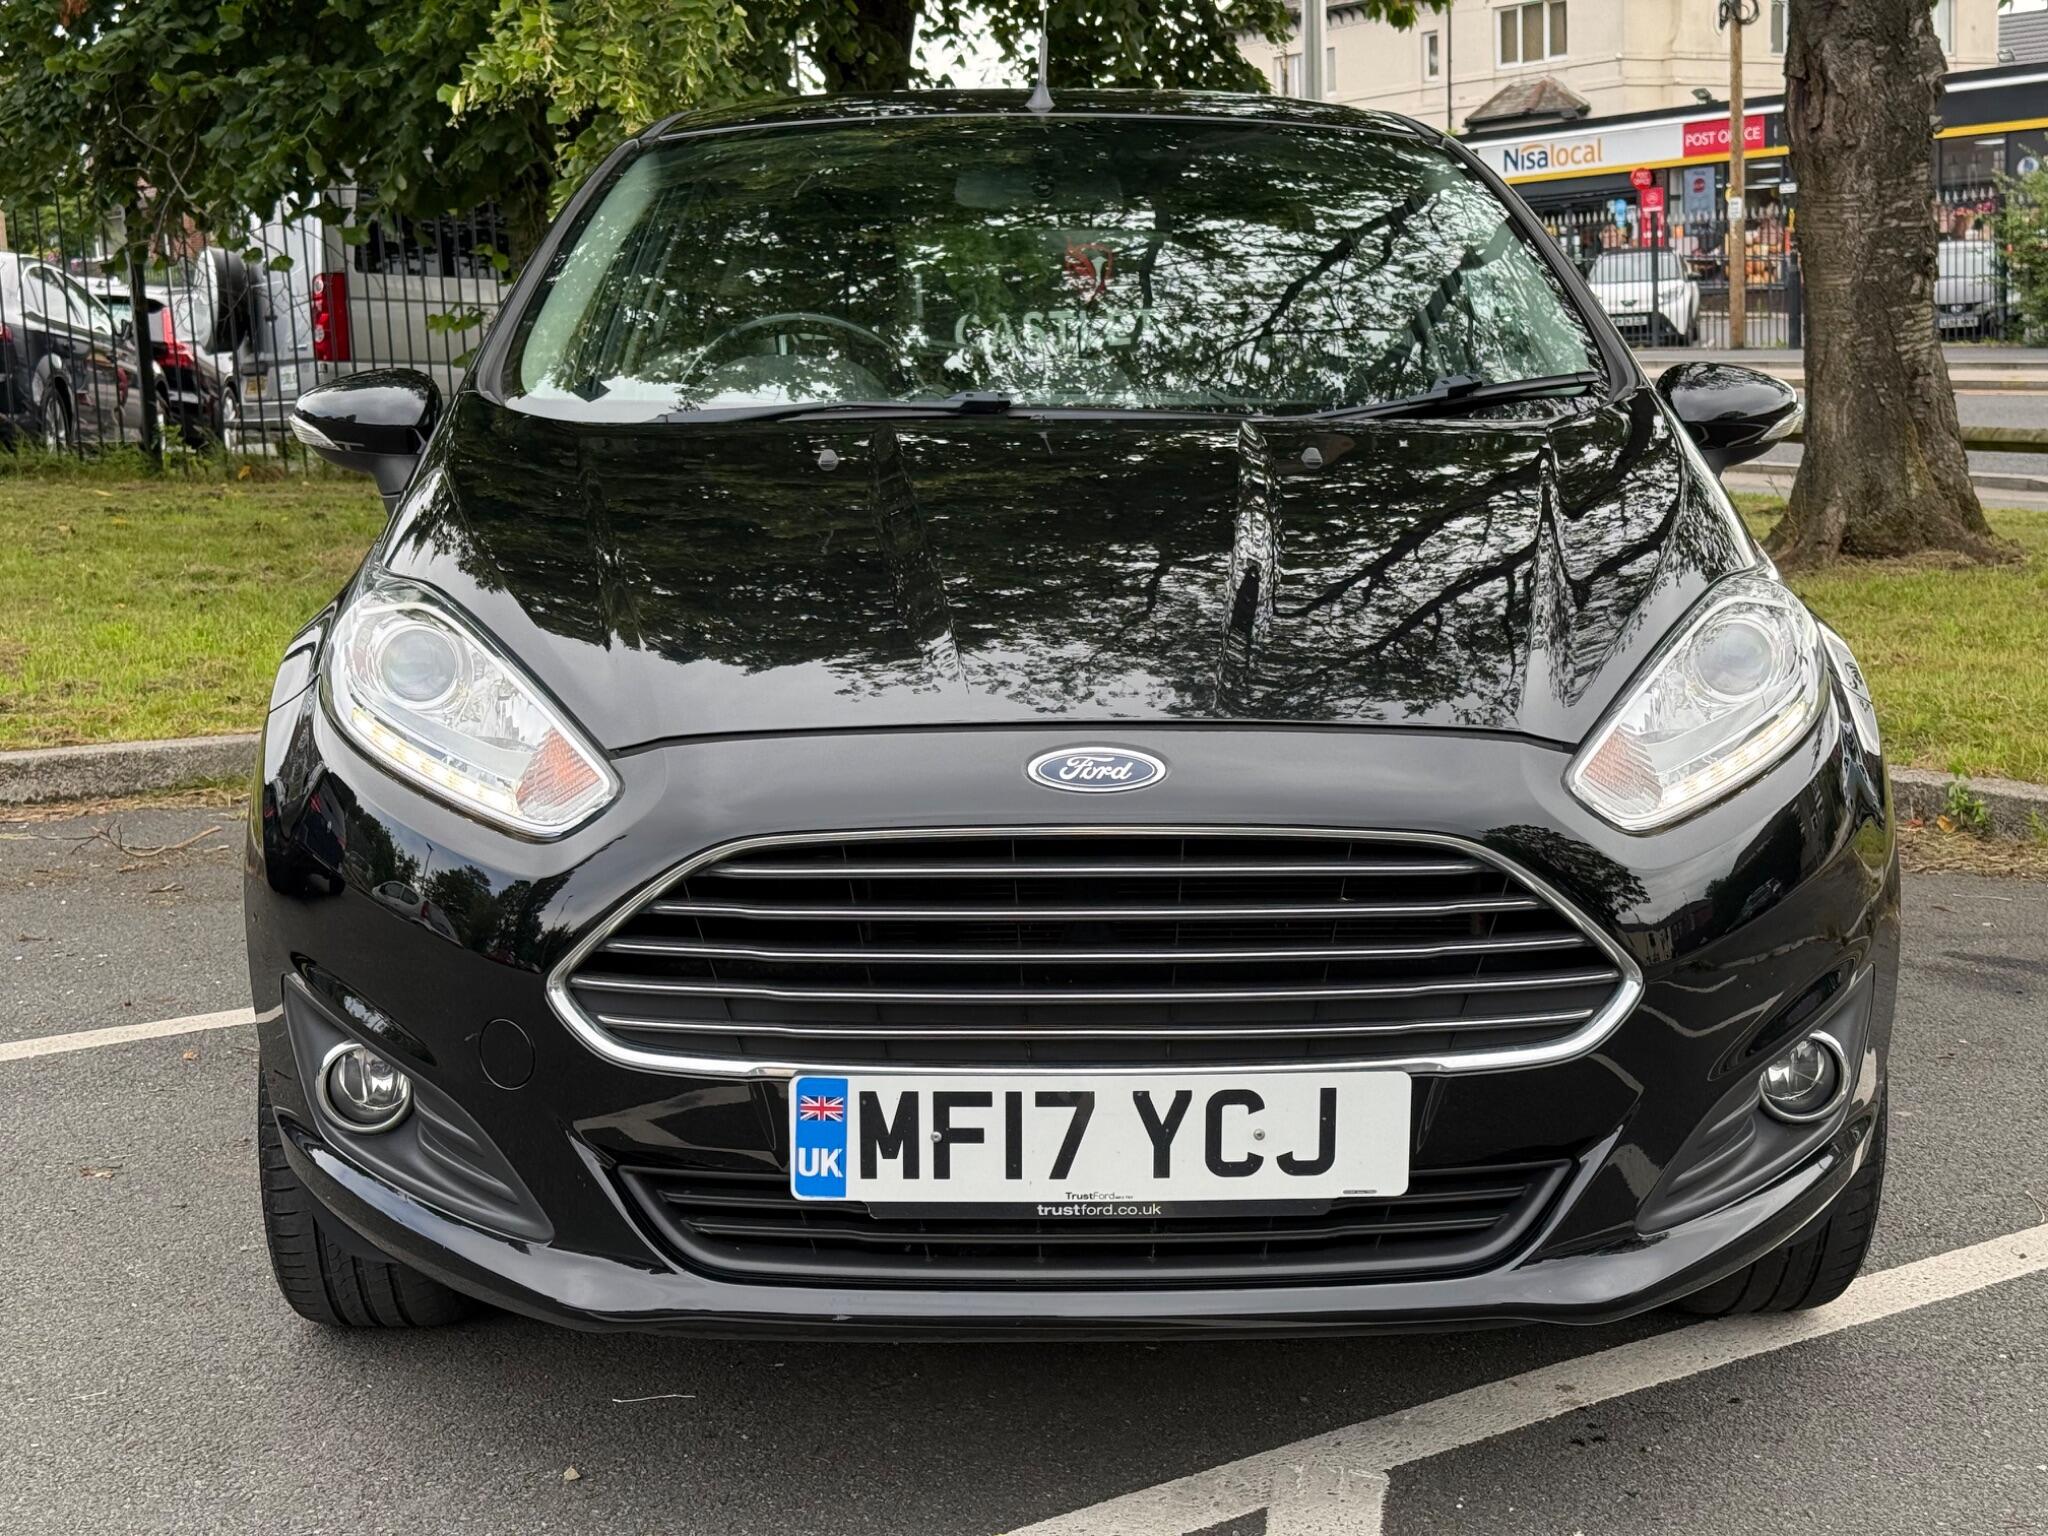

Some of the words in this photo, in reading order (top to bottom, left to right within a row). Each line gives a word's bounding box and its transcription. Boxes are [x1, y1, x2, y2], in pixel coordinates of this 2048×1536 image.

[1685, 131, 1716, 147] POST
[1717, 126, 1761, 144] OCE
[1059, 756, 1134, 780] Ford
[859, 1090, 1096, 1180] MF17
[1132, 1087, 1338, 1178] YCJ
[797, 1147, 843, 1178] UK
[1065, 1191, 1115, 1200] TrustFord
[1037, 1203, 1162, 1216] trustford.co.uk
